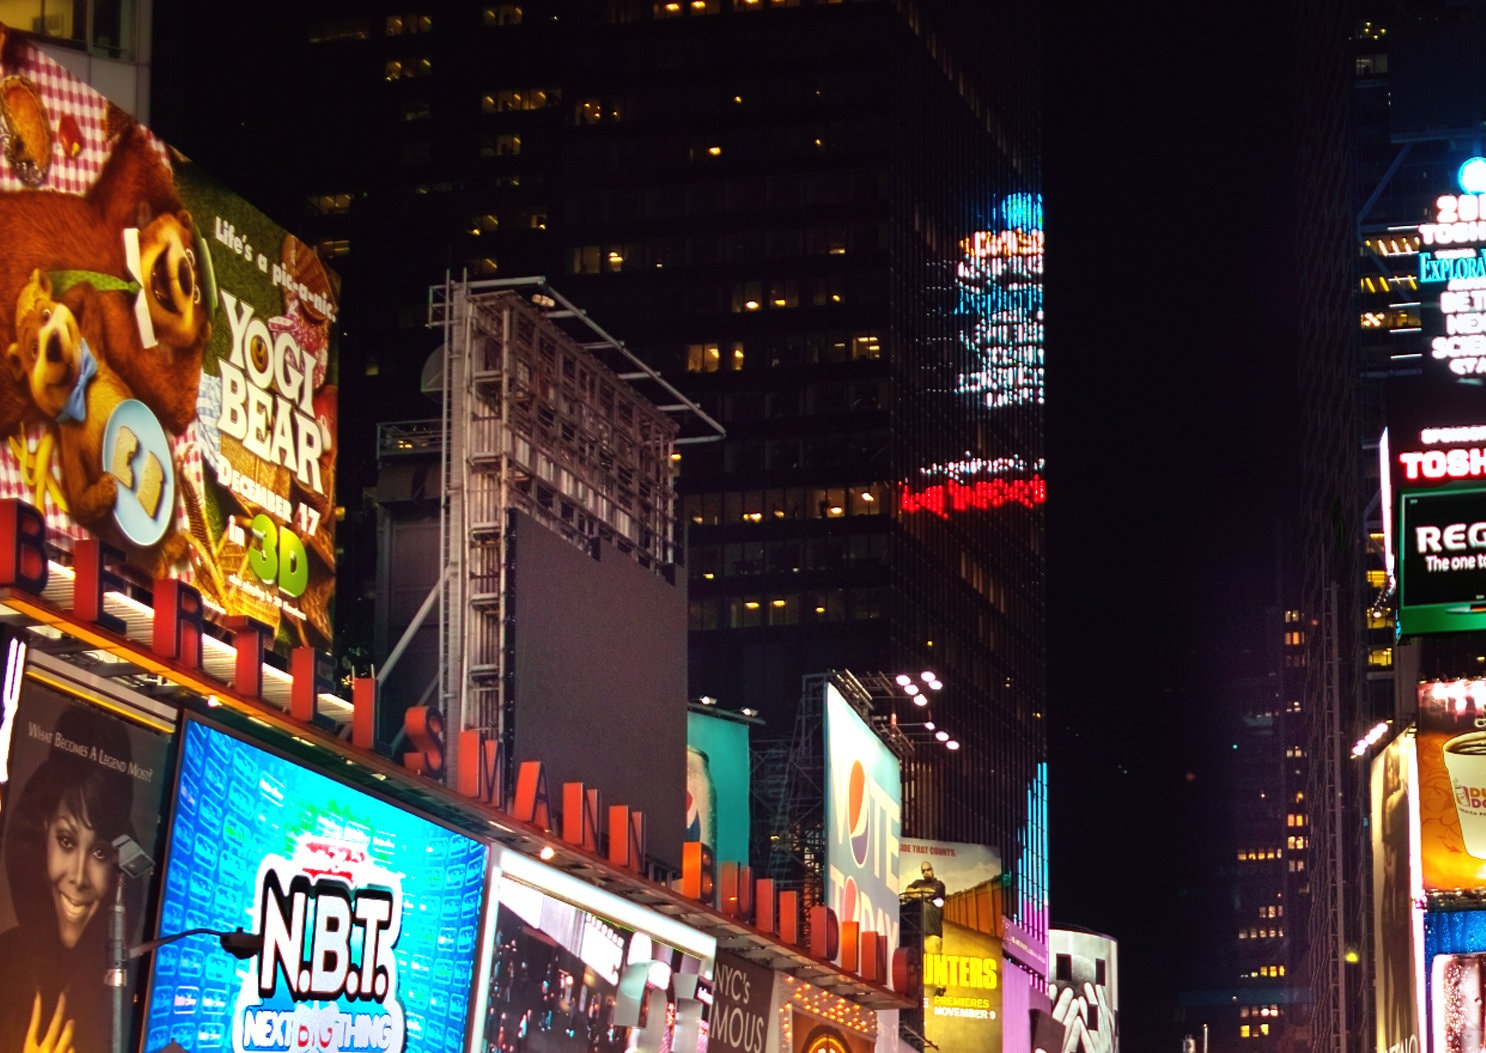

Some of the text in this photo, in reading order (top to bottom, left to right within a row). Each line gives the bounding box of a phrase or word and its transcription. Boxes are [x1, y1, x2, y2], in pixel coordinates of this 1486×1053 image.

[215, 216, 252, 261] Life's
[257, 253, 268, 273] a
[219, 288, 317, 416] YOGI
[217, 357, 328, 499] BEAR
[217, 455, 321, 536] DECEMBER 17
[228, 513, 309, 598] in 3D
[1425, 555, 1449, 573] The
[1451, 554, 1476, 569] one
[713, 962, 751, 1004] NYC's
